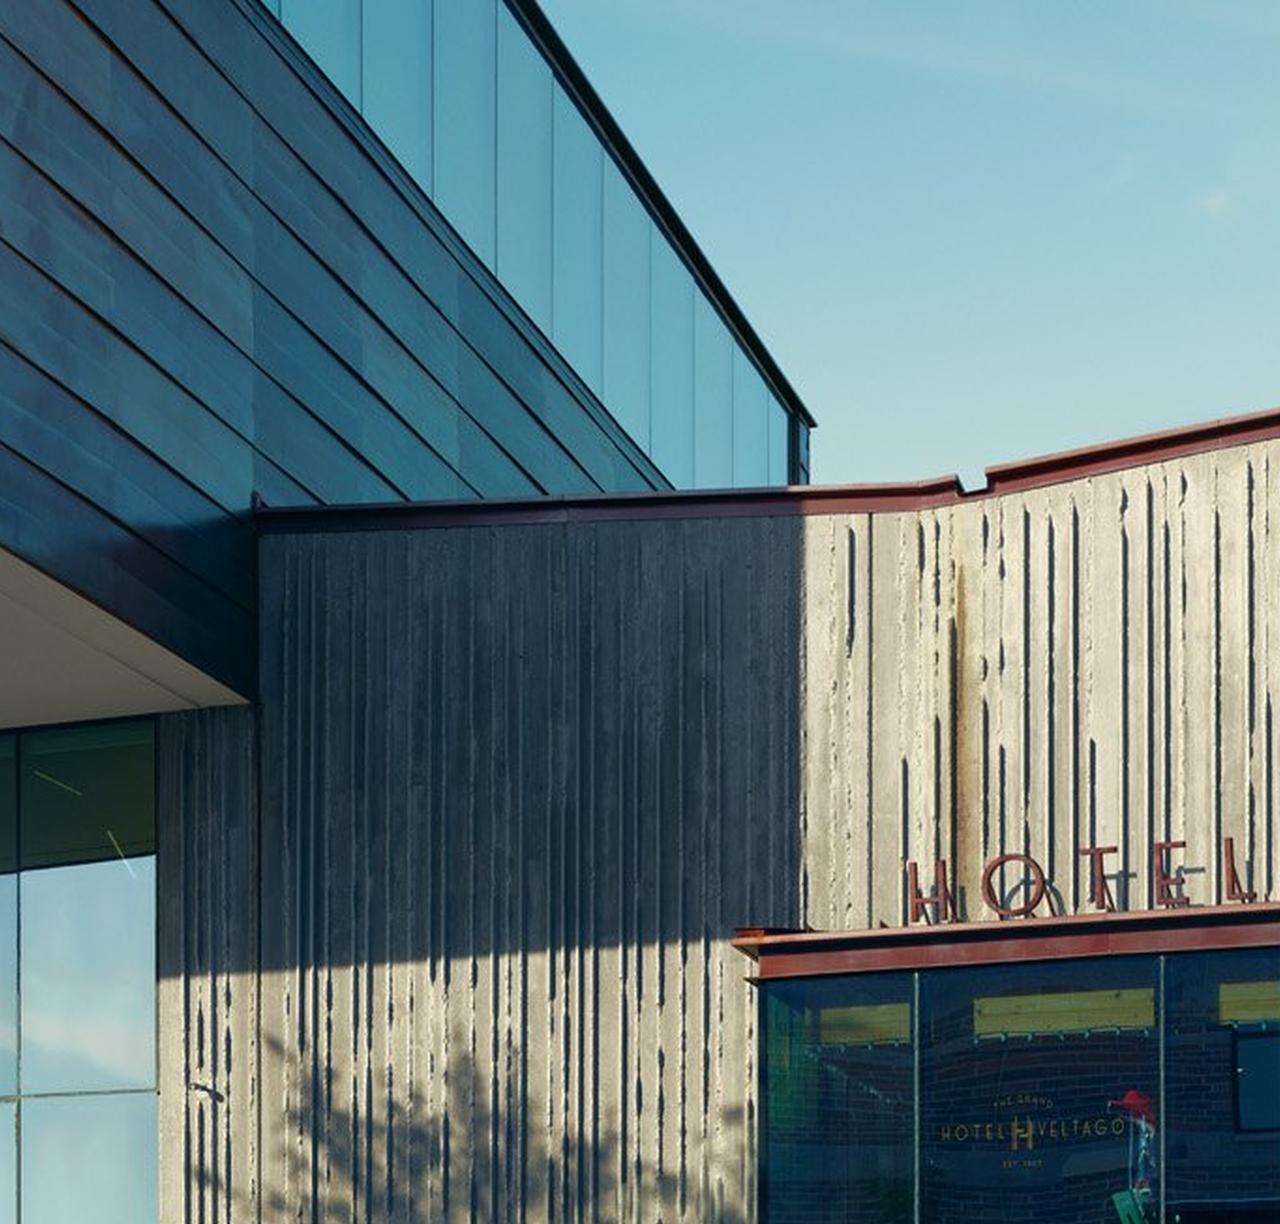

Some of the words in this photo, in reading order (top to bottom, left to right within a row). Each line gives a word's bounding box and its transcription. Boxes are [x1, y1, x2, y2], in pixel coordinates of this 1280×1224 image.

[908, 837, 1258, 923] HOTEL
[941, 1122, 1005, 1142] HOTEL
[1039, 1118, 1125, 1138] VELTAGO
